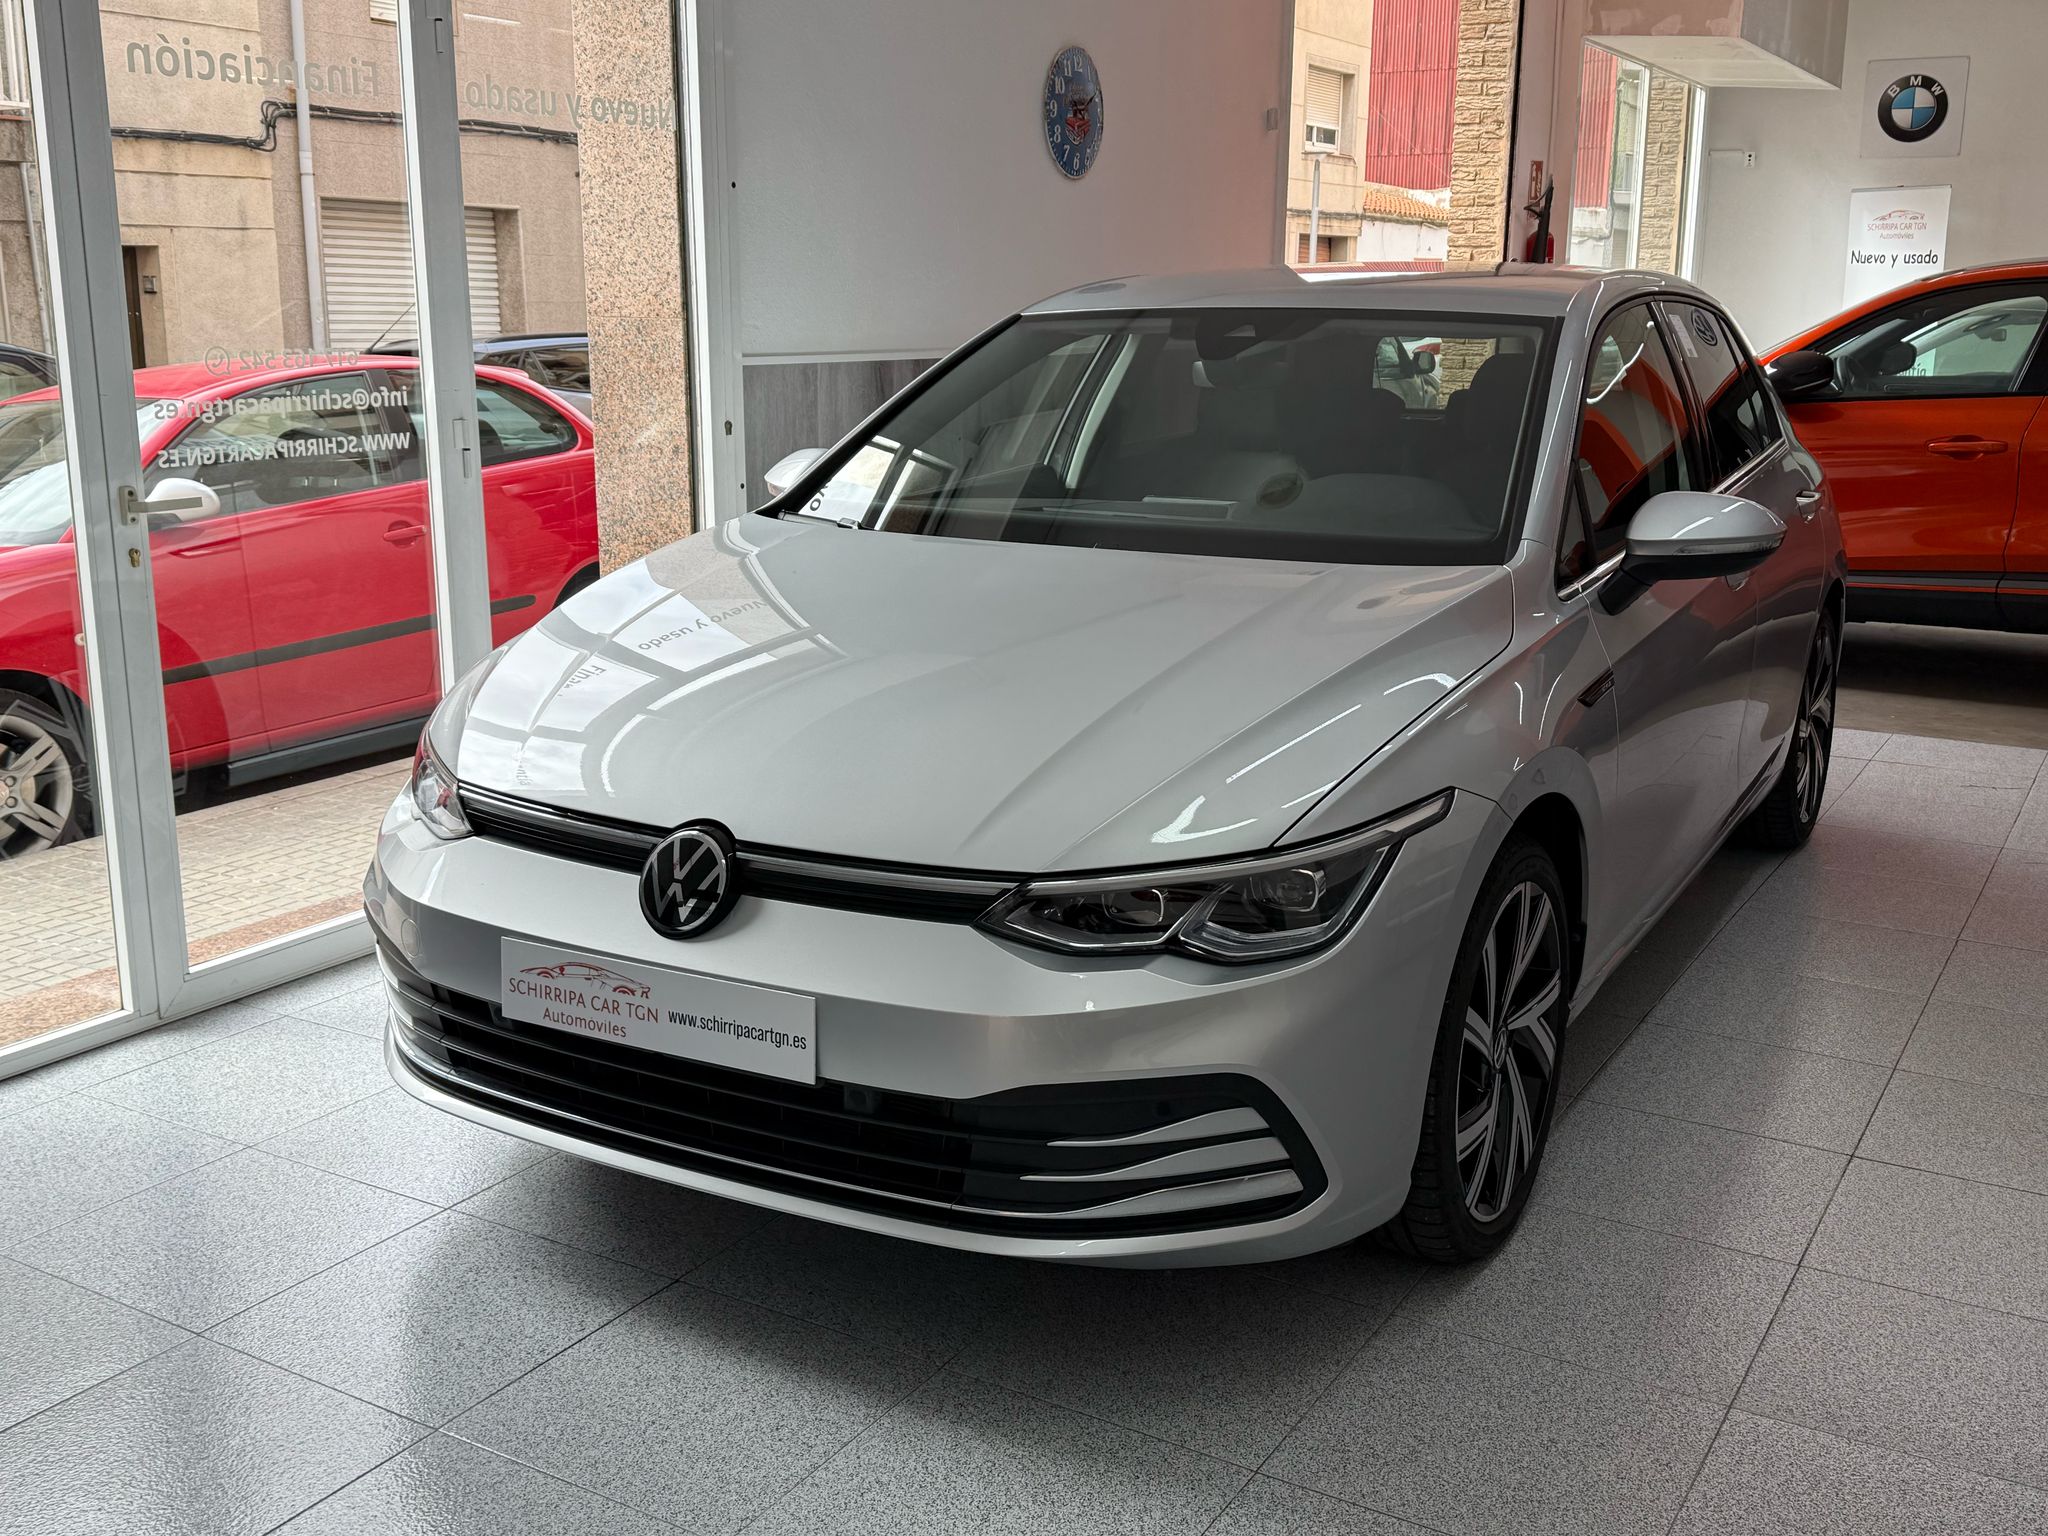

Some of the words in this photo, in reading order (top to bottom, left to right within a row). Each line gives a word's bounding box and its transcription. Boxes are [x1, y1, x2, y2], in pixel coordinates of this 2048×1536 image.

[1887, 75, 1944, 98] BMW
[1049, 99, 1058, 118] 9
[1053, 124, 1061, 144] 8
[1063, 144, 1070, 162] 7
[1867, 222, 1899, 232] SCHIRRIPA
[1899, 222, 1913, 231] CAR
[1913, 222, 1928, 230] TGN
[1850, 249, 1886, 265] Nuevo
[1891, 253, 1899, 269] y
[1903, 249, 1939, 264] usado
[509, 977, 587, 1009] SCHIRRIPA
[590, 995, 621, 1016] CAR
[625, 1002, 659, 1024] TGN
[668, 1010, 807, 1050] www.schirripacartgn.es
[542, 1007, 627, 1038] Automóviles
